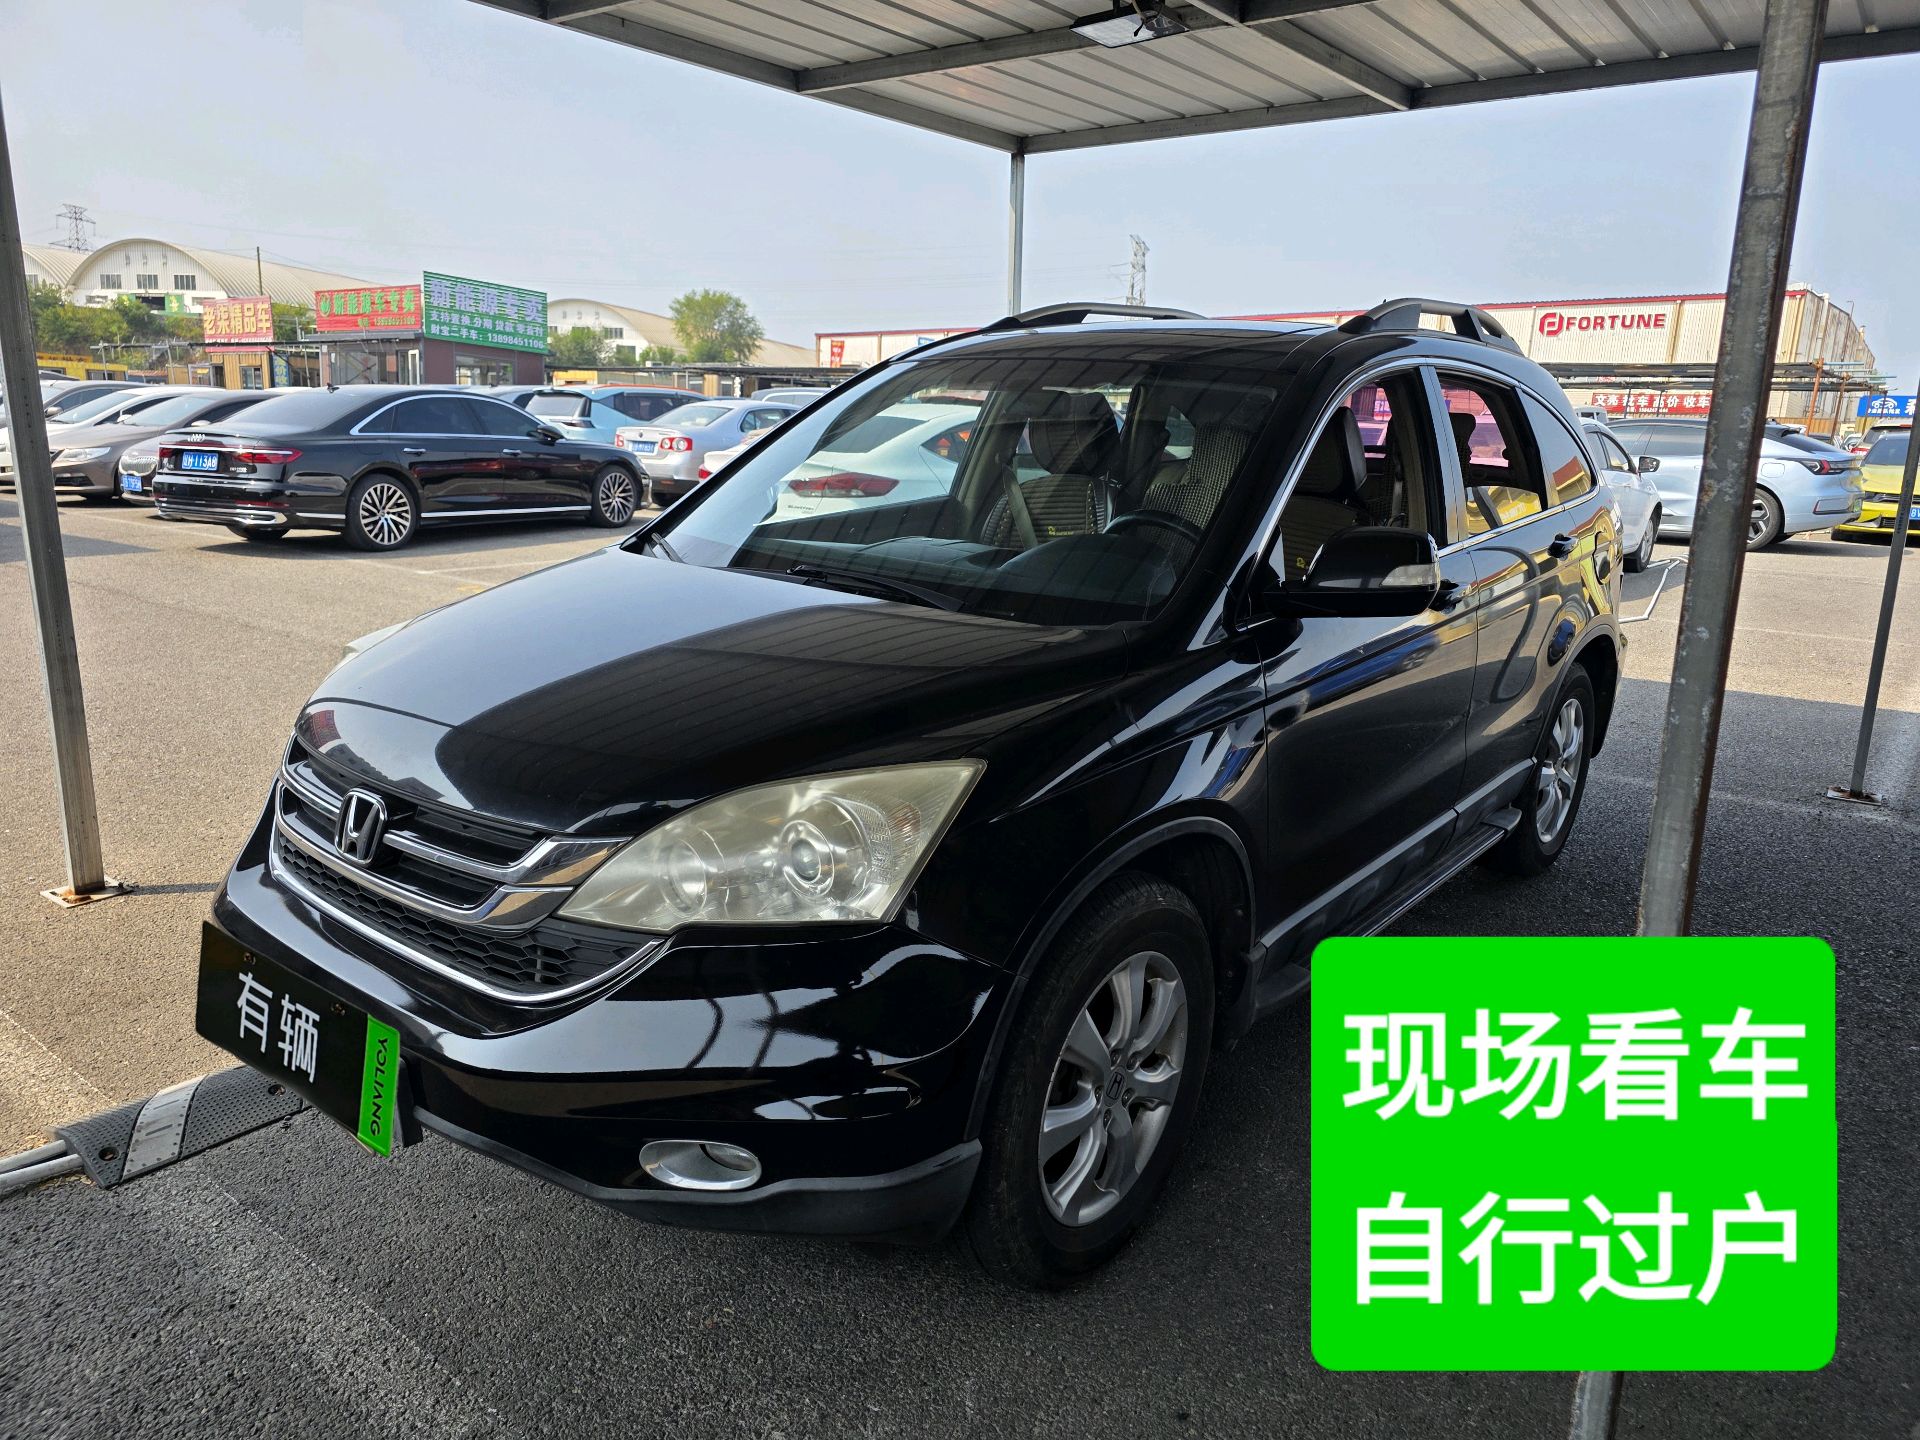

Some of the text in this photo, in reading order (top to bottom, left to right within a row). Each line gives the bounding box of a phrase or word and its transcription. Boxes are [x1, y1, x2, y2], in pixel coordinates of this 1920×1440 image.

[334, 289, 414, 315] 新能源车专卖
[429, 280, 542, 322] 新能源专卖
[1566, 313, 1667, 331] FORTUNE
[236, 972, 320, 1083] 有辆
[369, 1037, 389, 1136] YOLIANG
